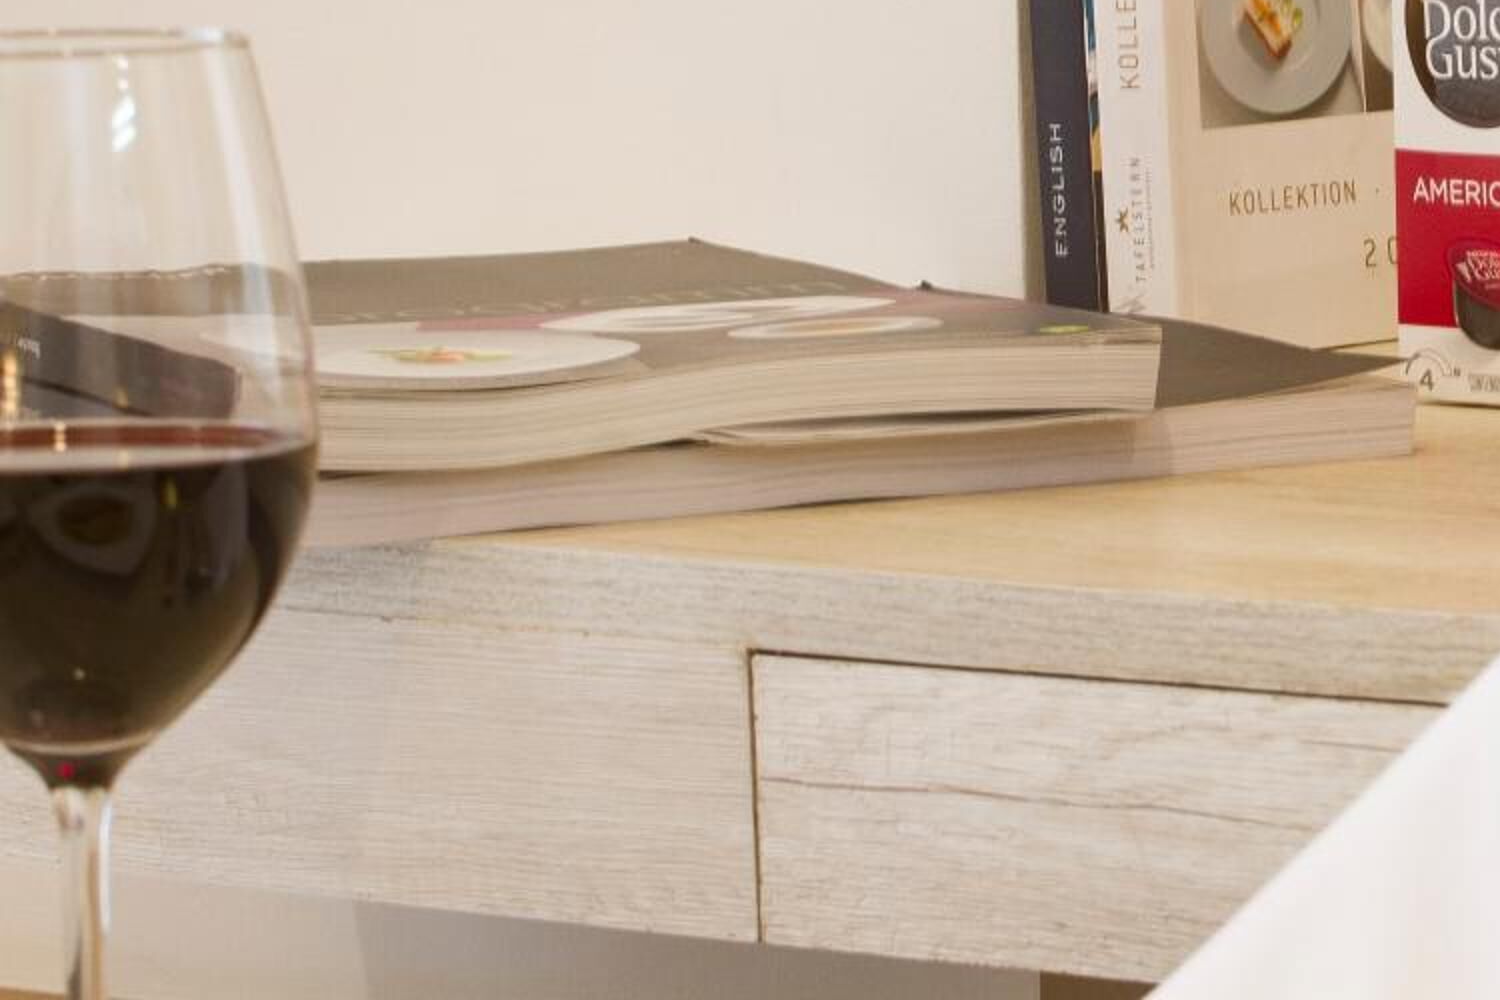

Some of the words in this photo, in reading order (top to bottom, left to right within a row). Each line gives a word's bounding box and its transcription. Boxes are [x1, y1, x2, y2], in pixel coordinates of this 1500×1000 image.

[1049, 123, 1068, 257] ENGLISH
[1130, 157, 1146, 282] TAFELSTERN
[1229, 178, 1357, 216] KOLLEKTION
[1419, 368, 1433, 391] 4
